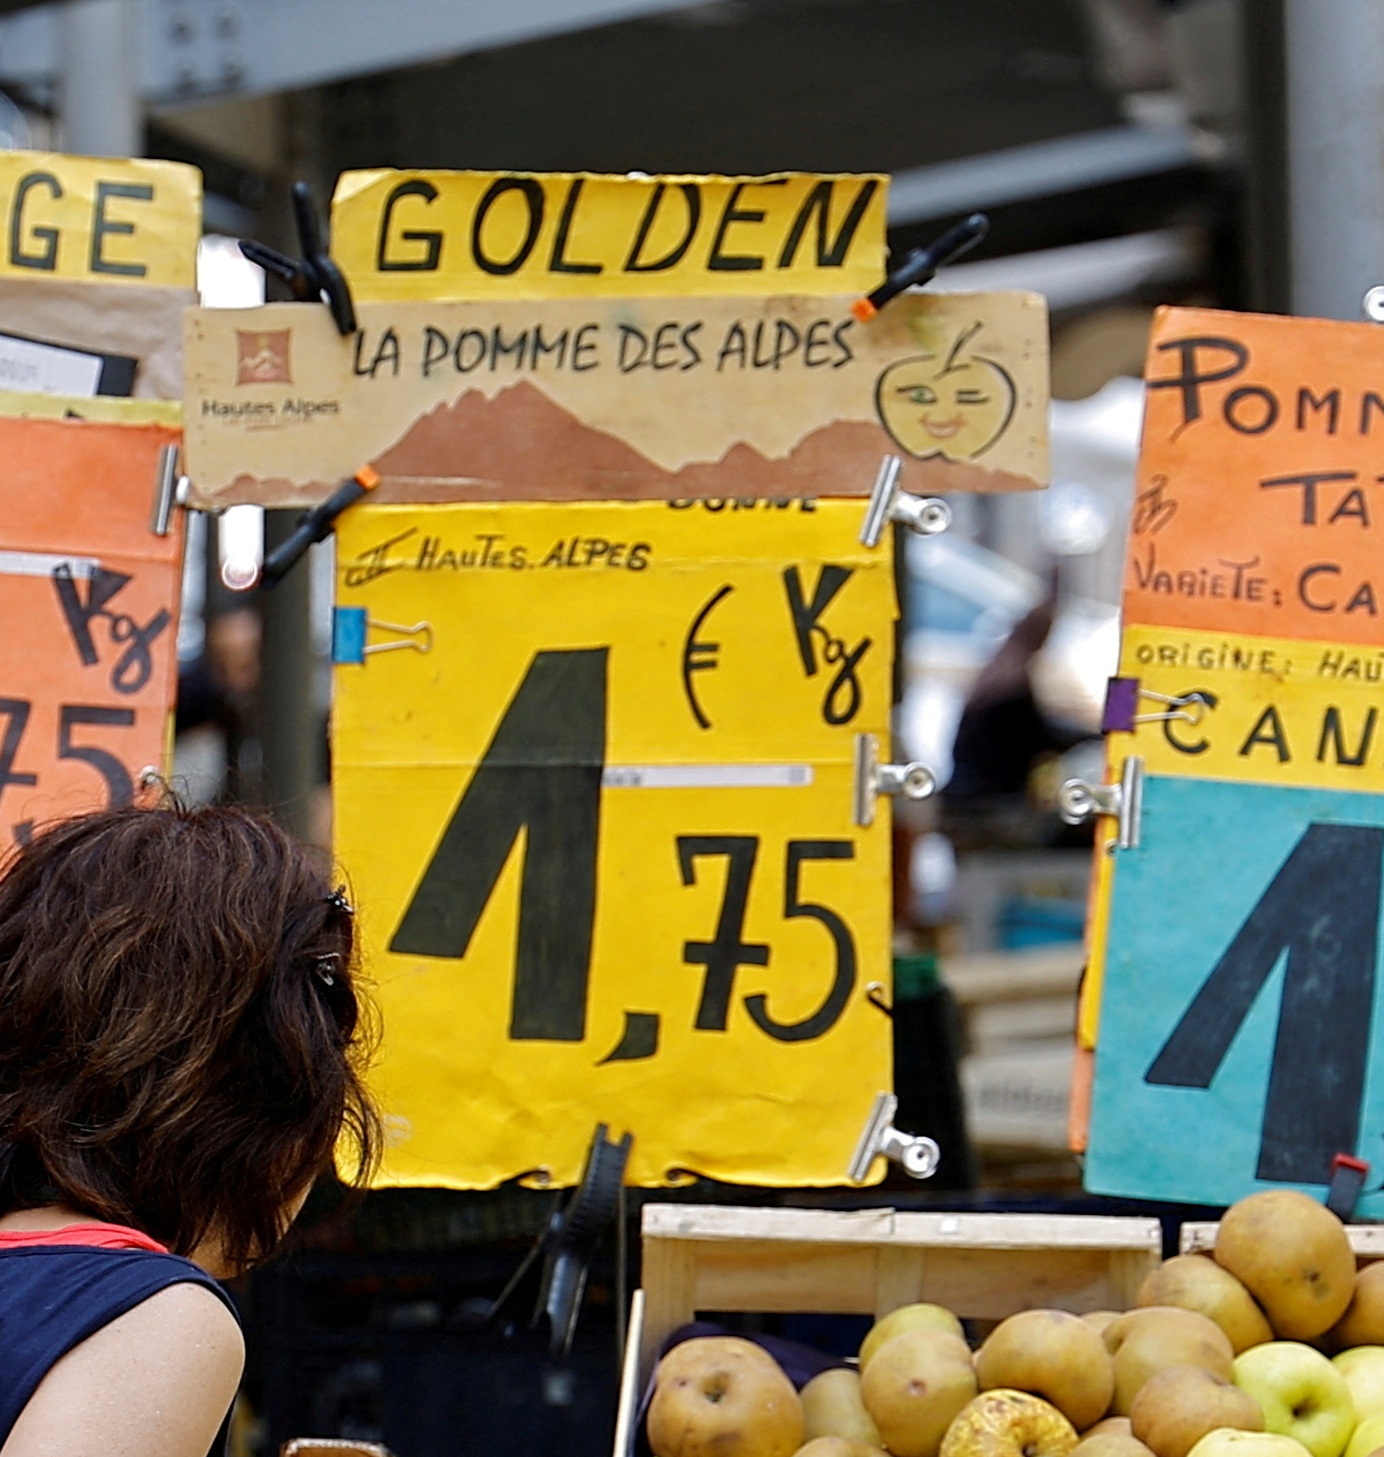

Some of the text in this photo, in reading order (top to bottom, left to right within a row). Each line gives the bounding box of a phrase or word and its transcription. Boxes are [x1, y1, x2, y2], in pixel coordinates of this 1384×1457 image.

[379, 177, 886, 276] GOLDEN
[351, 318, 853, 379] LA POMME DES ALPES
[202, 400, 340, 418] Hautes Alpes
[541, 535, 652, 571] ALPES
[389, 647, 858, 1066] 1,75
